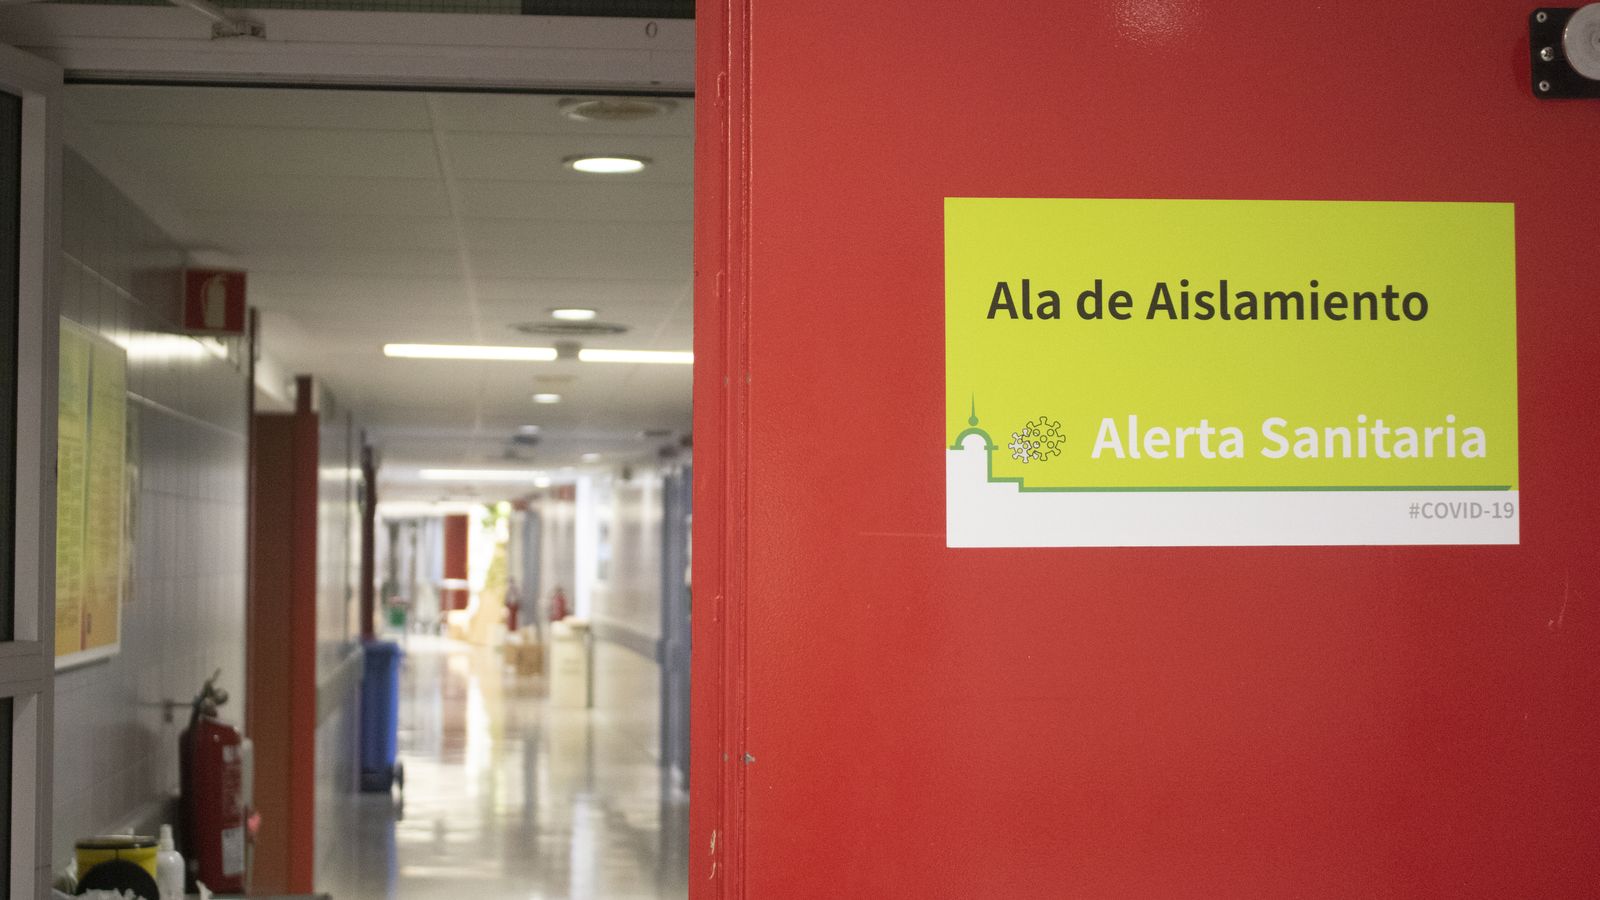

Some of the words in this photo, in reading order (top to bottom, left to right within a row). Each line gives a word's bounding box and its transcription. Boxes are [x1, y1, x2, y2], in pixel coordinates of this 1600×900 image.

[986, 278, 1061, 321] Ala
[1076, 278, 1133, 321] de
[1145, 278, 1429, 322] Aislamiento
[1091, 414, 1245, 460] Alerta
[1260, 412, 1486, 460] Sanitaria
[1408, 501, 1515, 520] #COVID-19
